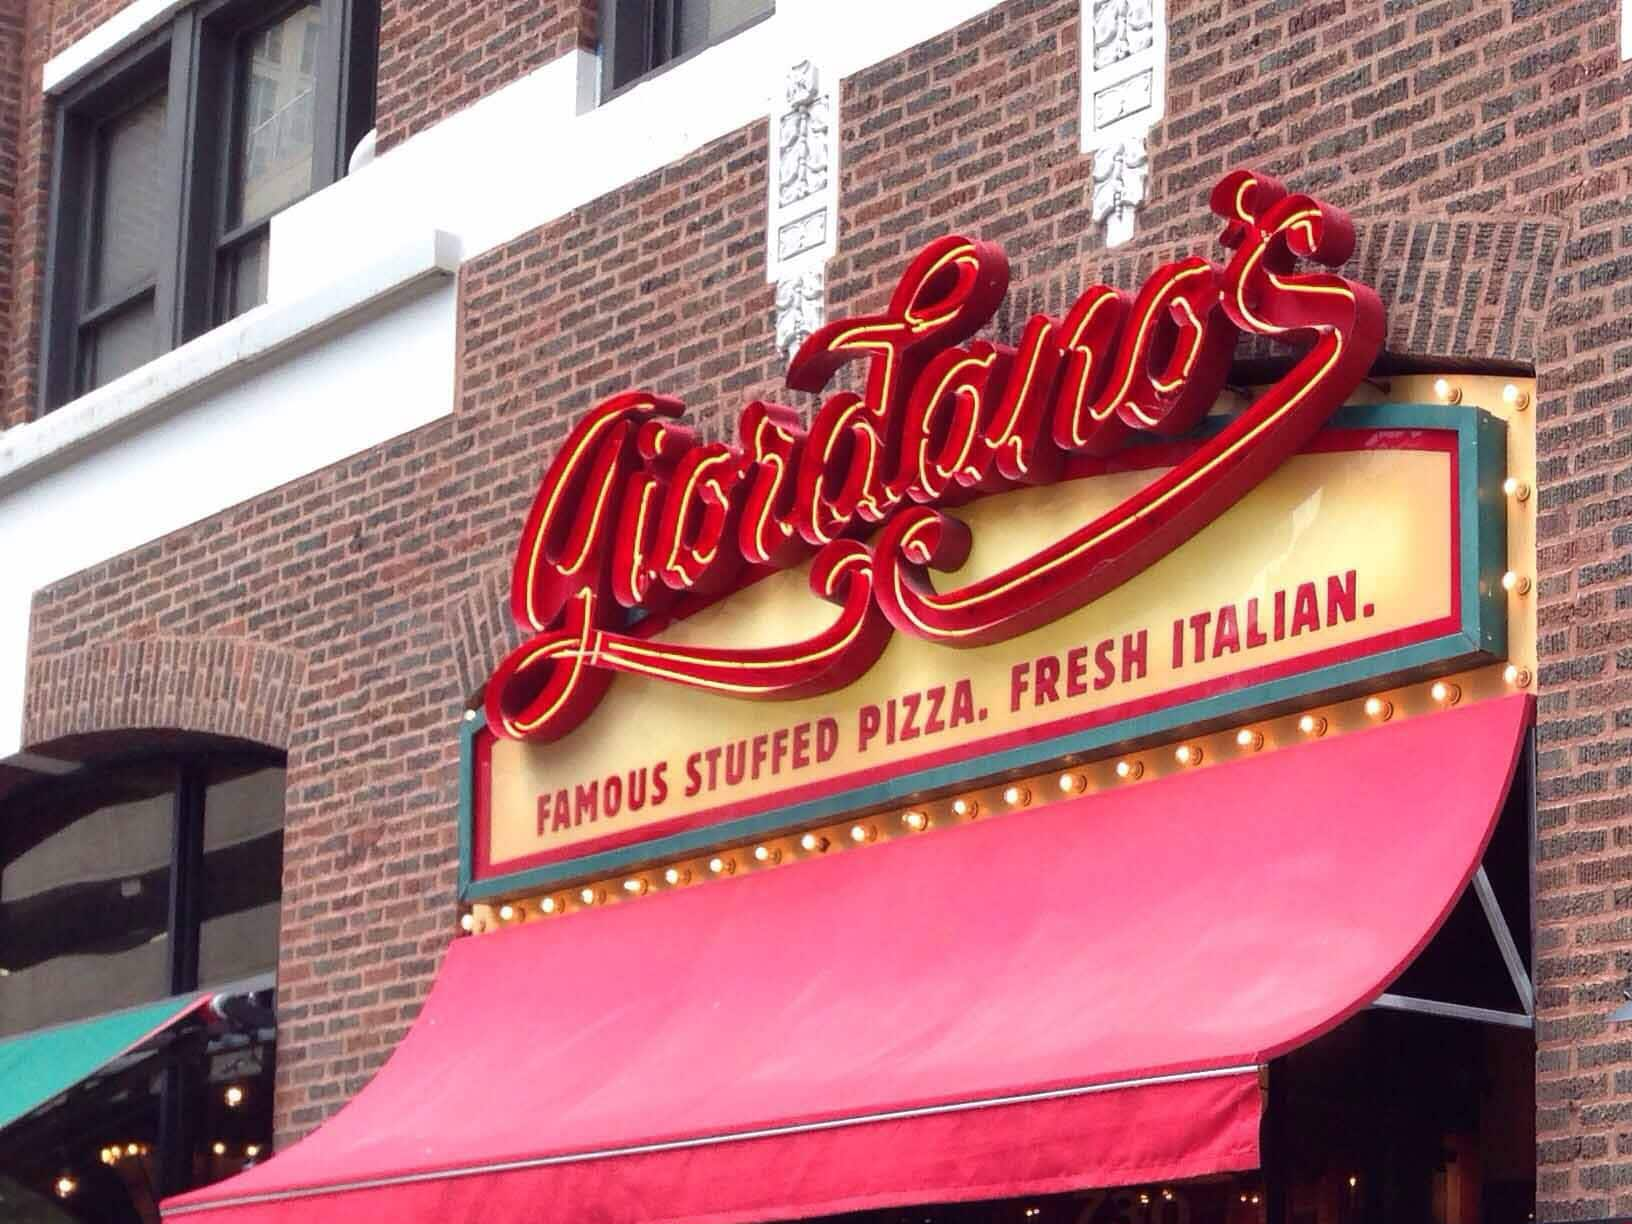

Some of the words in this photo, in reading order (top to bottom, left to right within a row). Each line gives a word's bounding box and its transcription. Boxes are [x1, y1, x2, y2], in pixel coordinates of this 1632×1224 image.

[484, 170, 1386, 742] Giordano's
[537, 761, 668, 836] FAMOUS
[685, 718, 838, 797] STUFFED
[858, 679, 988, 752] PIZZA.
[1010, 629, 1148, 713] FRESH
[1171, 569, 1375, 670] ITALIAN.
